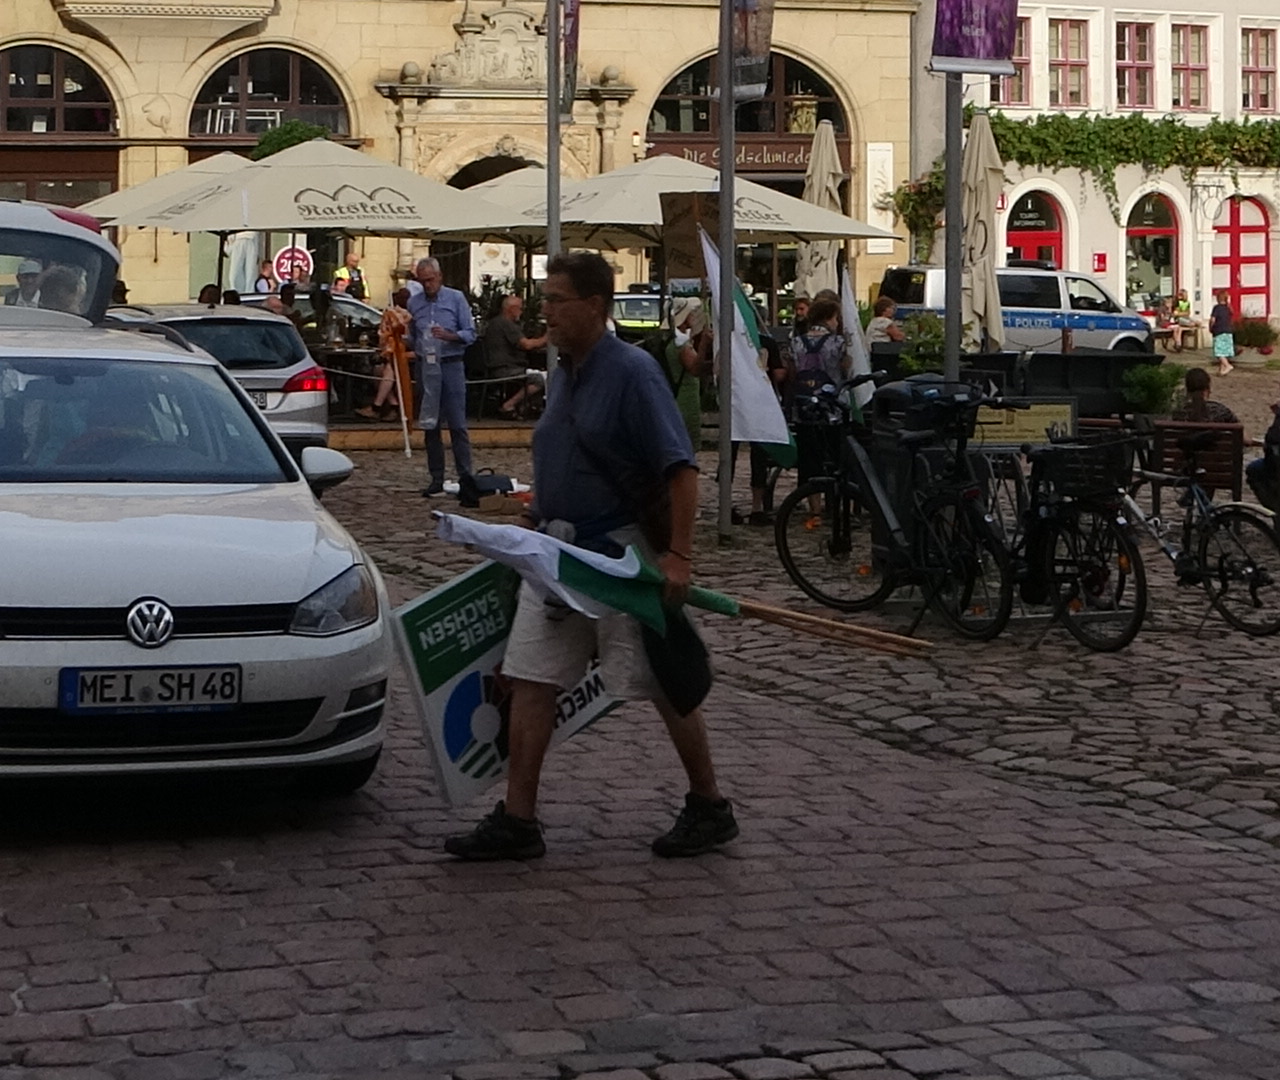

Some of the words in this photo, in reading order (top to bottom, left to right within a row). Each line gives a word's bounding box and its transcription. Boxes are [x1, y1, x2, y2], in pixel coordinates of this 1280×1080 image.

[711, 145, 812, 165] Gdschmiede
[297, 202, 418, 216] Ratskeller
[1015, 320, 1052, 328] POLIZEI
[249, 391, 266, 405] 58
[419, 590, 499, 650] SACHSEN
[456, 609, 507, 652] FREIE
[80, 674, 135, 703] MEI
[157, 673, 195, 701] SH
[201, 671, 236, 700] 48
[553, 672, 606, 729] WECH
